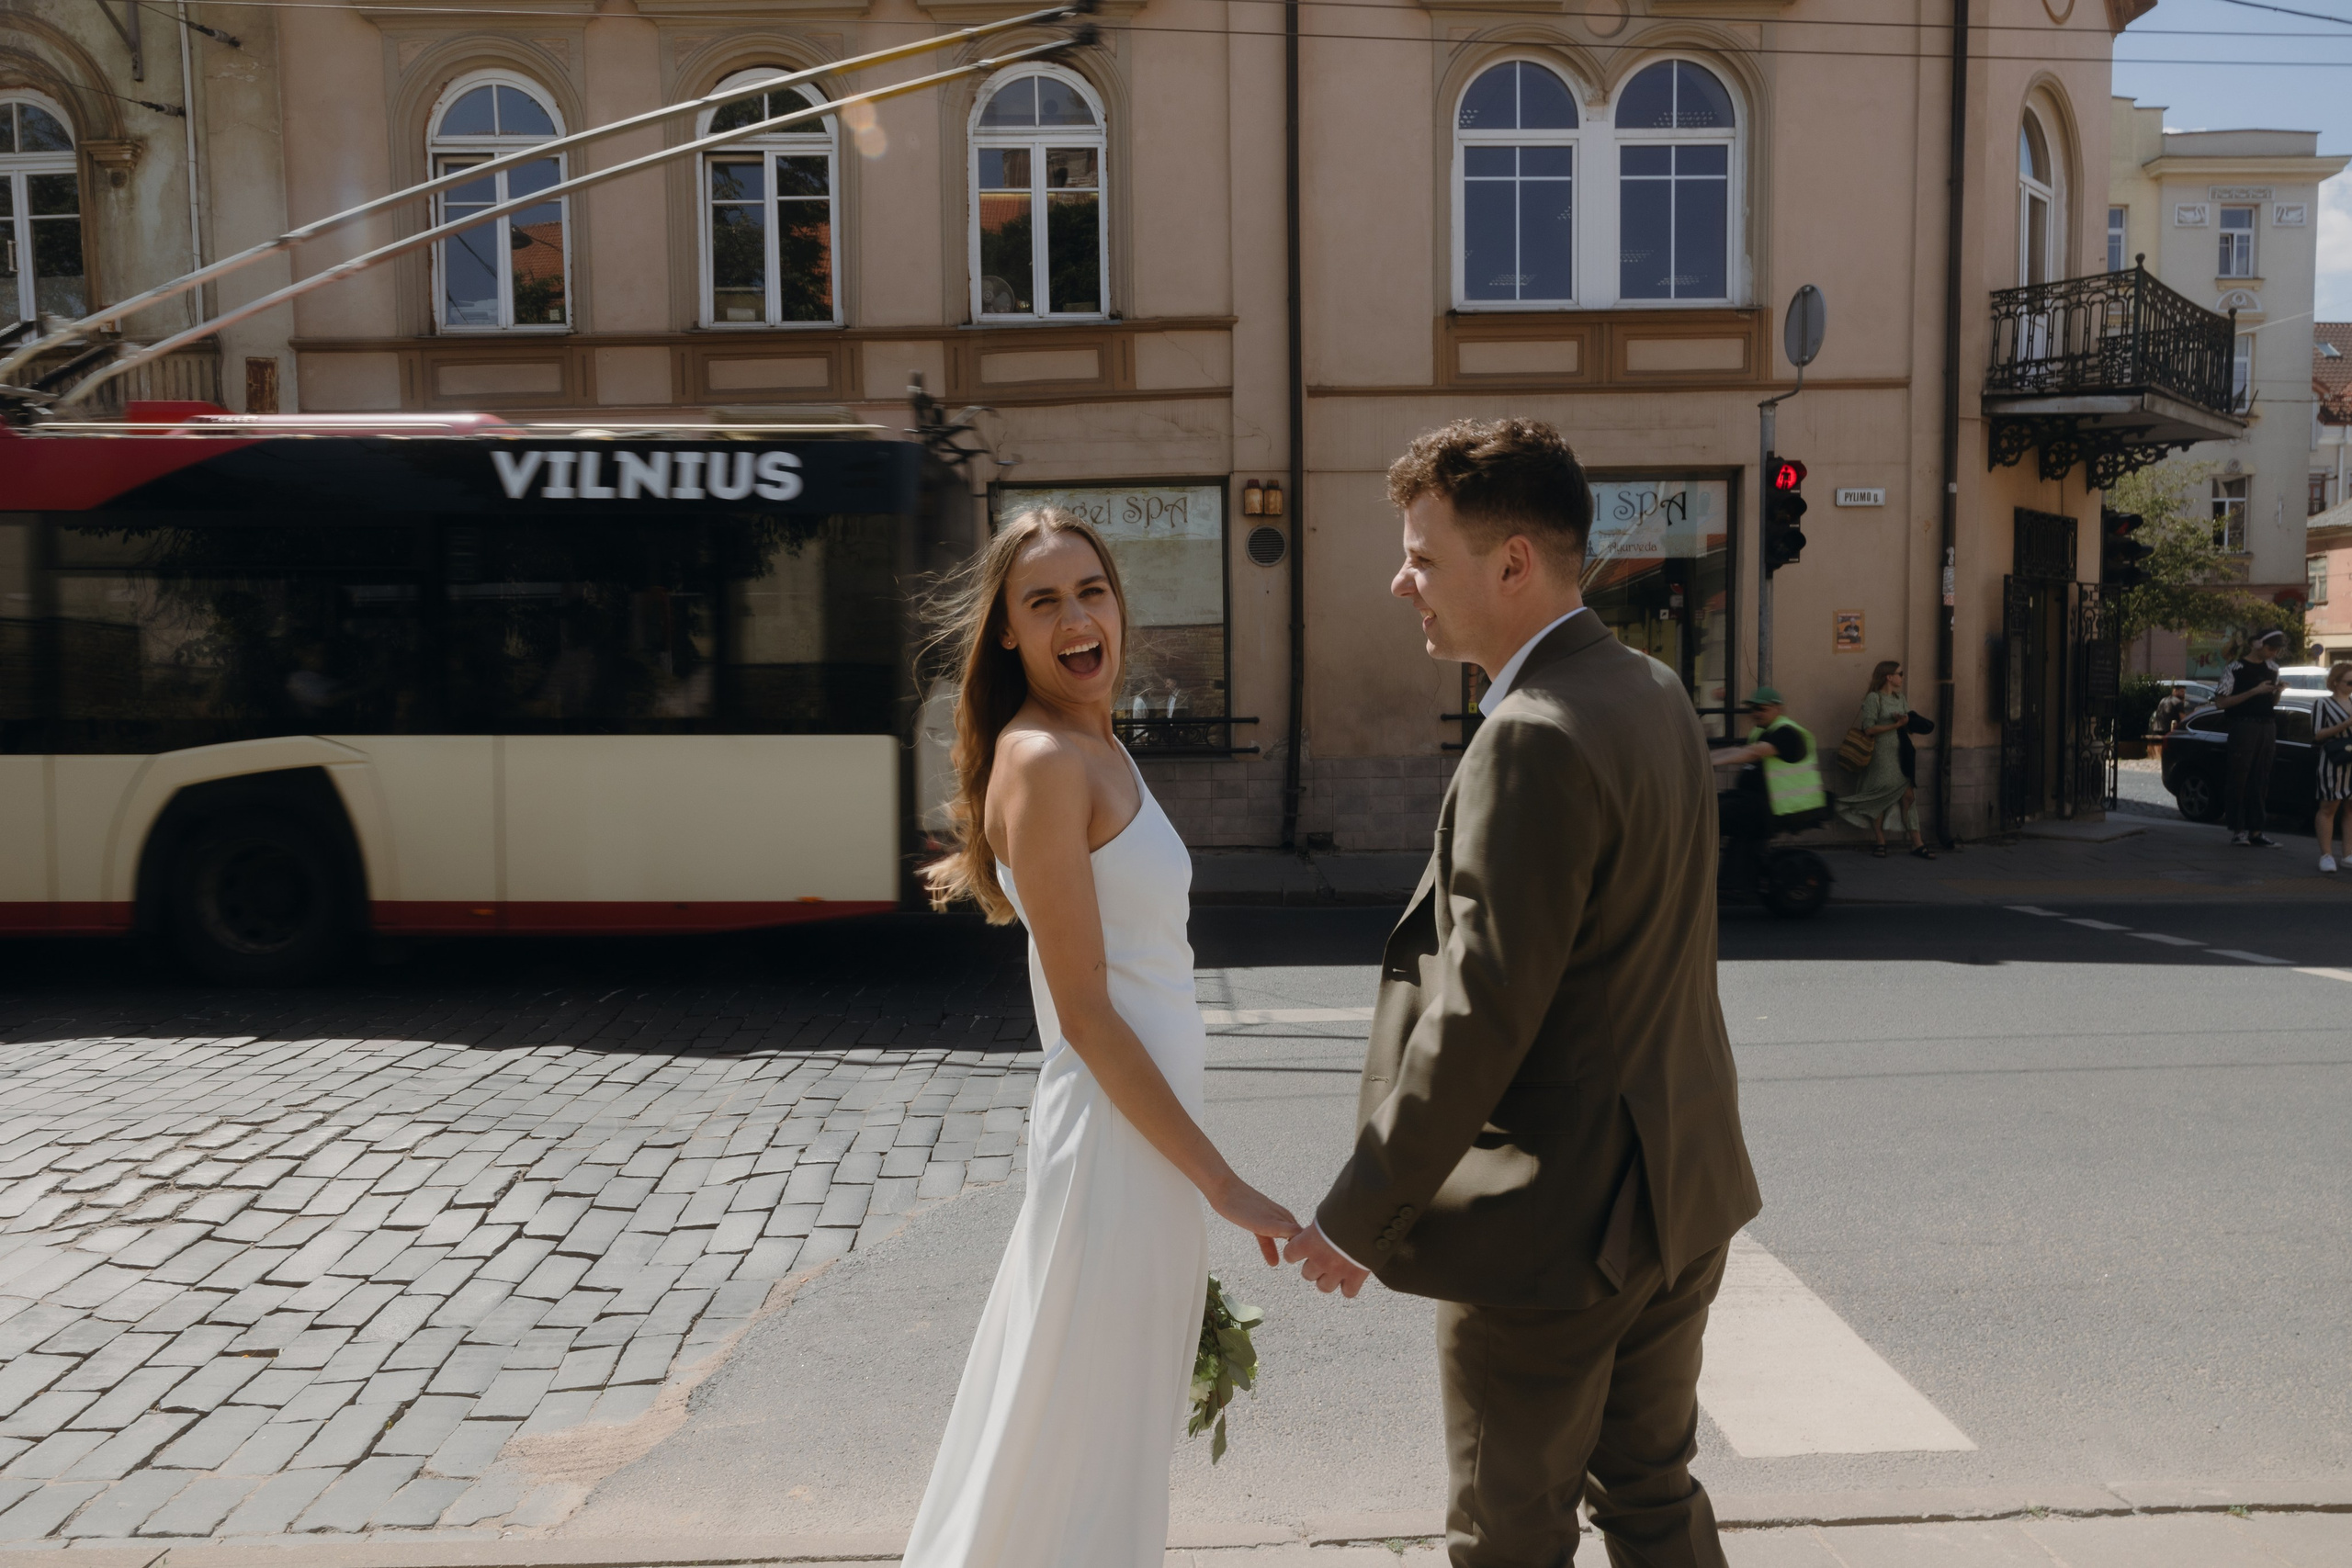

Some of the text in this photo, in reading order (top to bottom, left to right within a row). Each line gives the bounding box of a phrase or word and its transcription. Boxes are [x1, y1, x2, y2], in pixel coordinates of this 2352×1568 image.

[490, 450, 804, 502] VILNIUS
[1122, 496, 1188, 529] SPA
[1613, 491, 1687, 526] SPA
[1844, 491, 1871, 502] PYLIMO
[1608, 541, 1657, 554] Ayurveda
